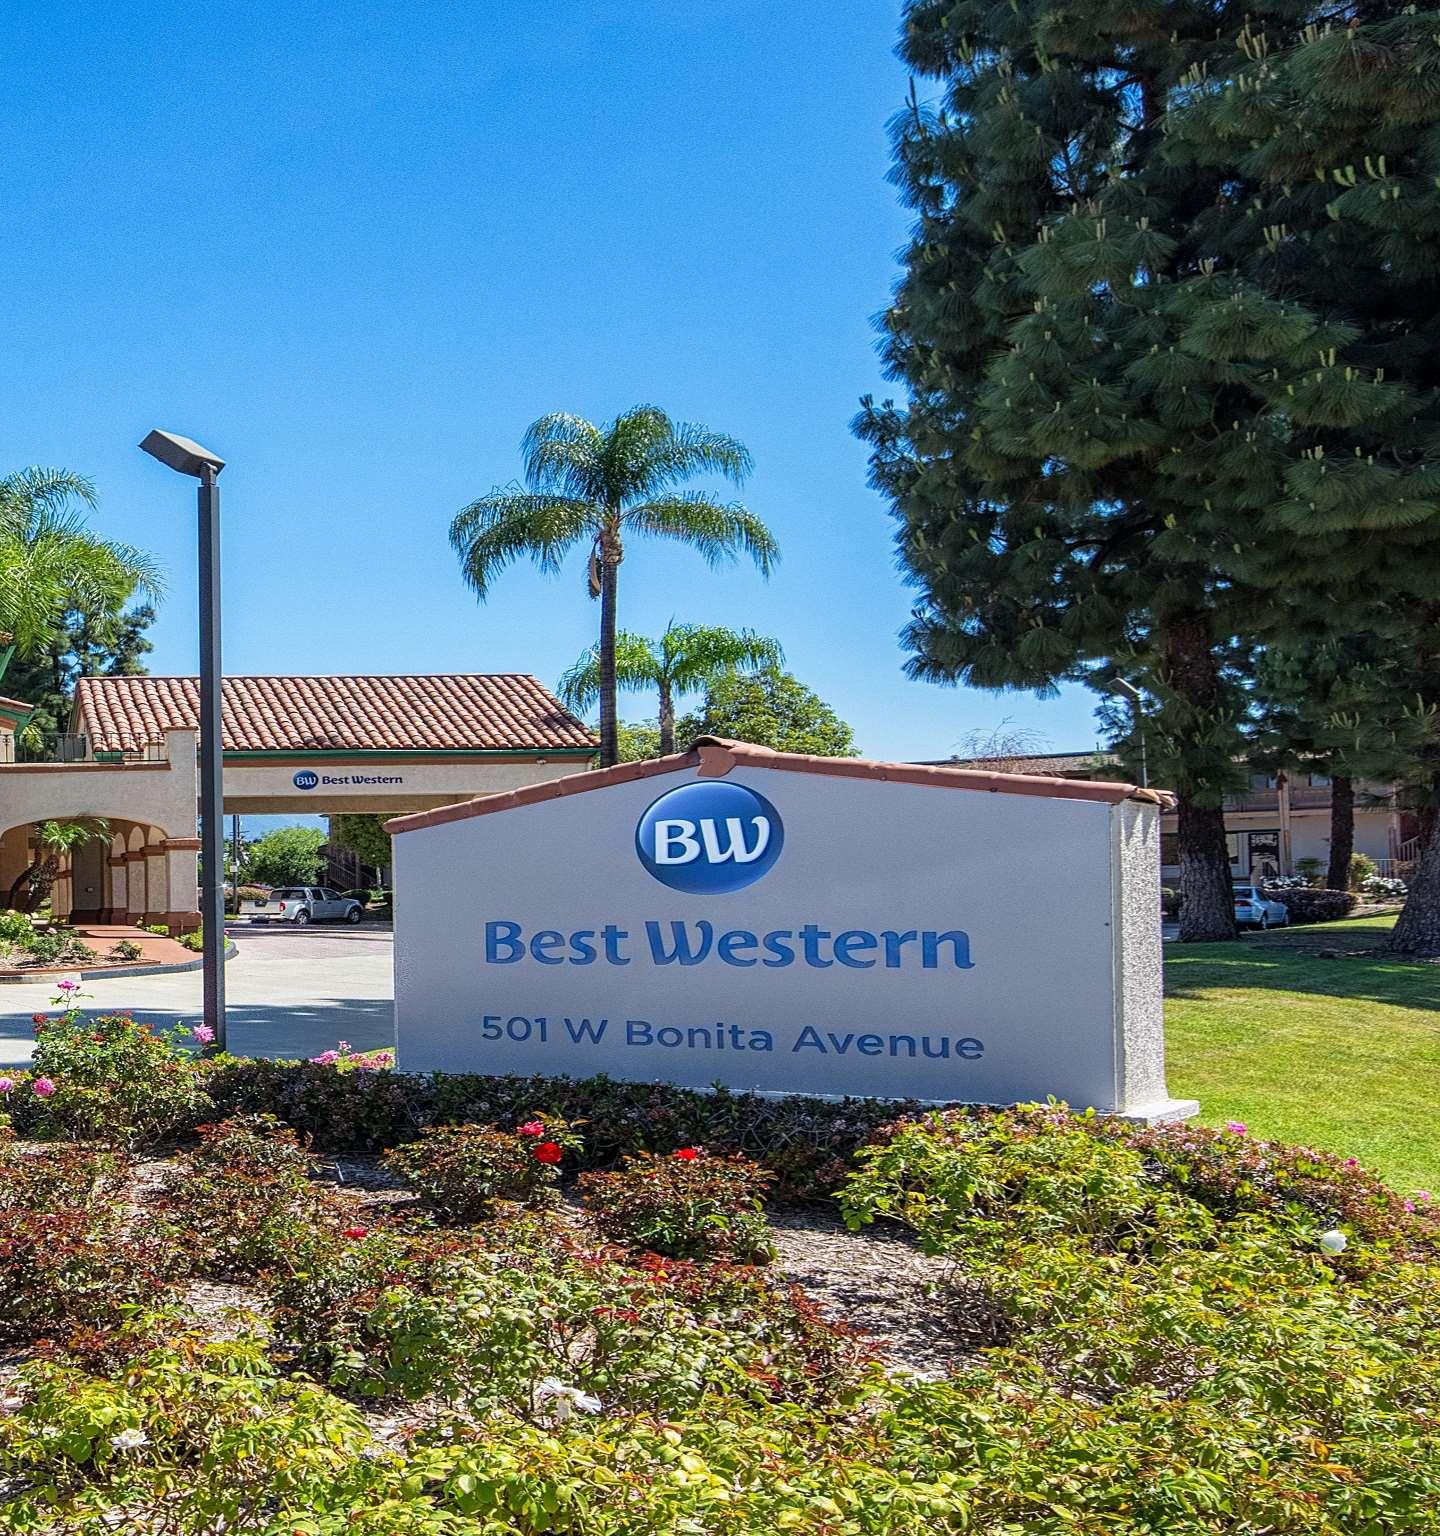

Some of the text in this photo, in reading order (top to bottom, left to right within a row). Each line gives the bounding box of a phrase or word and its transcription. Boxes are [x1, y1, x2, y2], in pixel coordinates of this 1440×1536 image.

[296, 775, 403, 785] BW Best Western
[654, 815, 771, 865] BW
[485, 919, 975, 970] Best Western
[481, 1014, 985, 1061] 501 W Bonita Avenue
